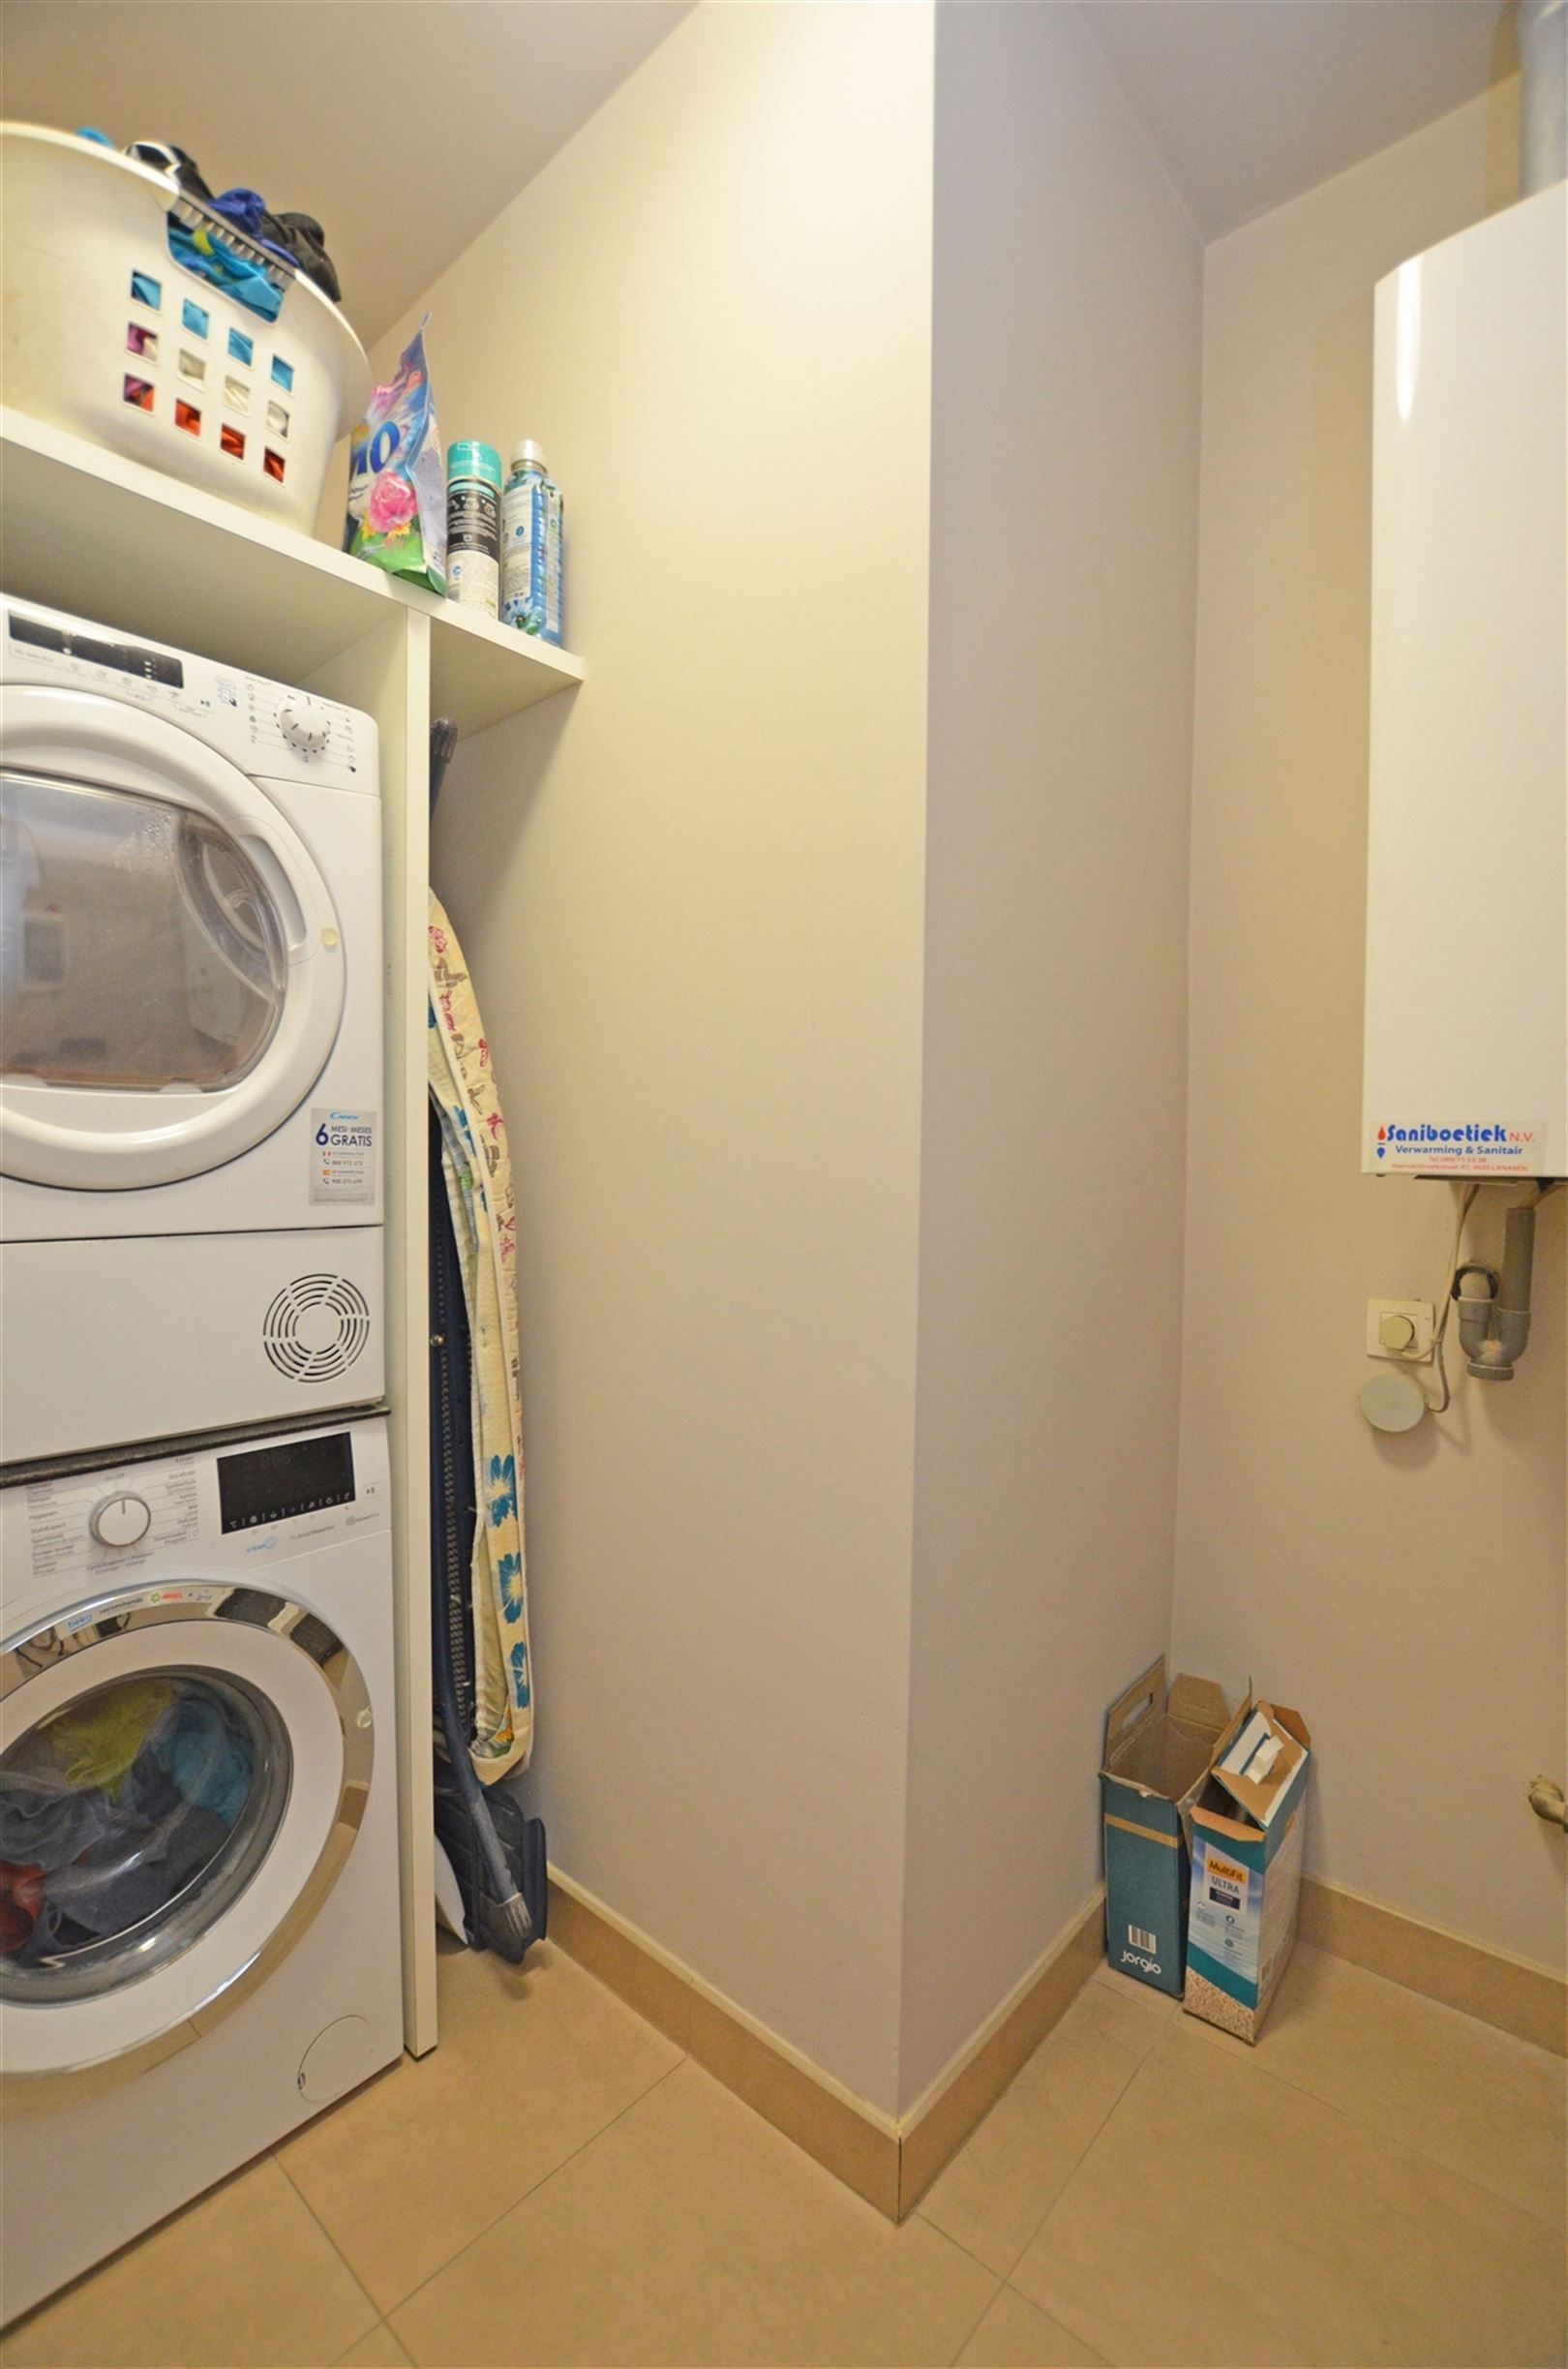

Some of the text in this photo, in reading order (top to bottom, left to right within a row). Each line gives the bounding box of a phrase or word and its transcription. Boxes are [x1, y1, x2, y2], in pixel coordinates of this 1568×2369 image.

[316, 1123, 329, 1146] 6
[330, 1135, 373, 1147] GRATIS
[1387, 1123, 1535, 1142] Saniboetiek N.V.
[1396, 1145, 1523, 1156] Verwarming & Sanitair
[1211, 1876, 1240, 1895] ULTRA
